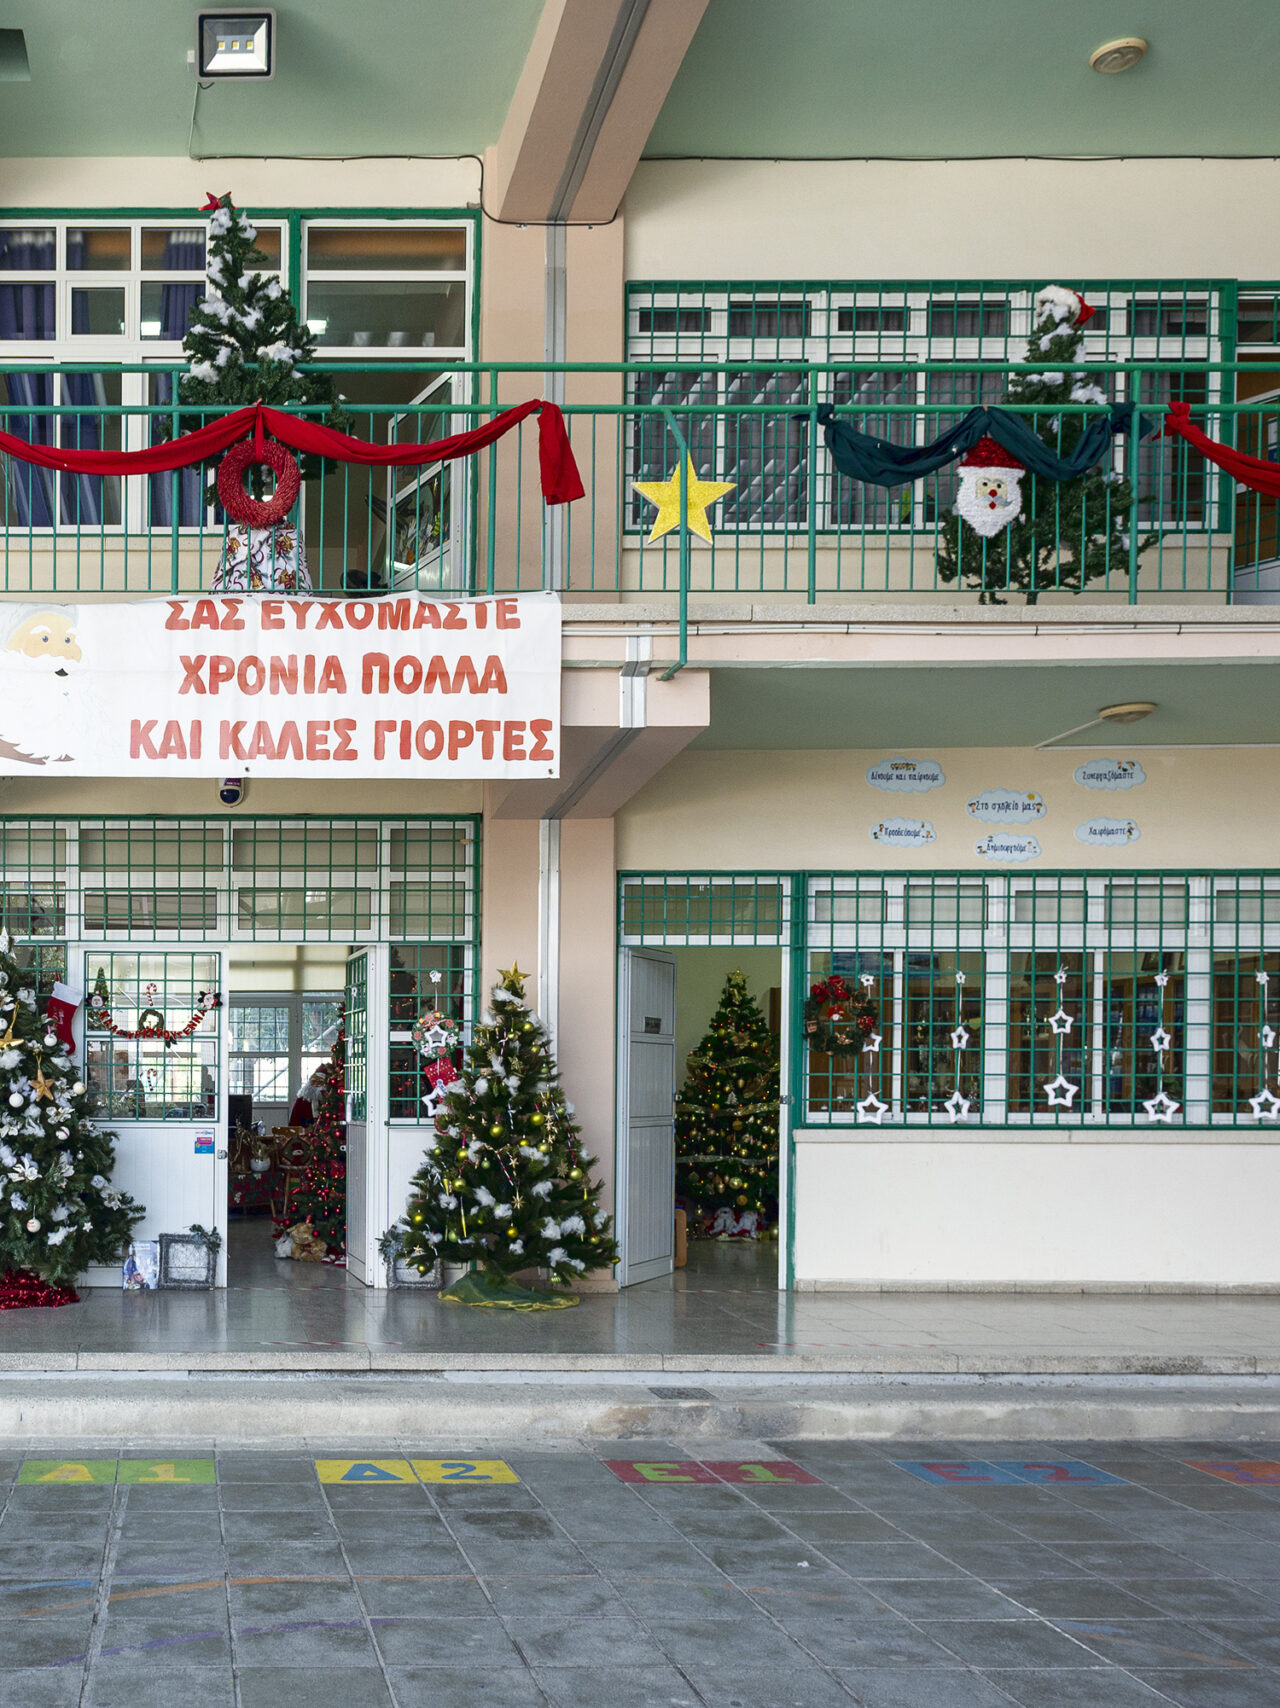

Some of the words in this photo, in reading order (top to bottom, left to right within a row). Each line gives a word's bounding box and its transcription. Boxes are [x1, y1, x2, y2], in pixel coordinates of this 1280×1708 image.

[165, 599, 245, 631] ΣΑΣ
[261, 598, 521, 631] ΕΥΧΟΜΑΣΤΕ
[178, 654, 347, 695] ΧΡΟΝΙΑ
[361, 653, 508, 695] ΠΟΛΛΑ
[130, 719, 202, 760] ΚΑΙ
[219, 718, 359, 761] ΚΑΛΕΣ
[373, 718, 554, 761] ΓΙΟΡΤΕΣ
[976, 800, 989, 811] Στο
[991, 800, 1019, 813] σχολείο
[1022, 801, 1036, 813] μας
